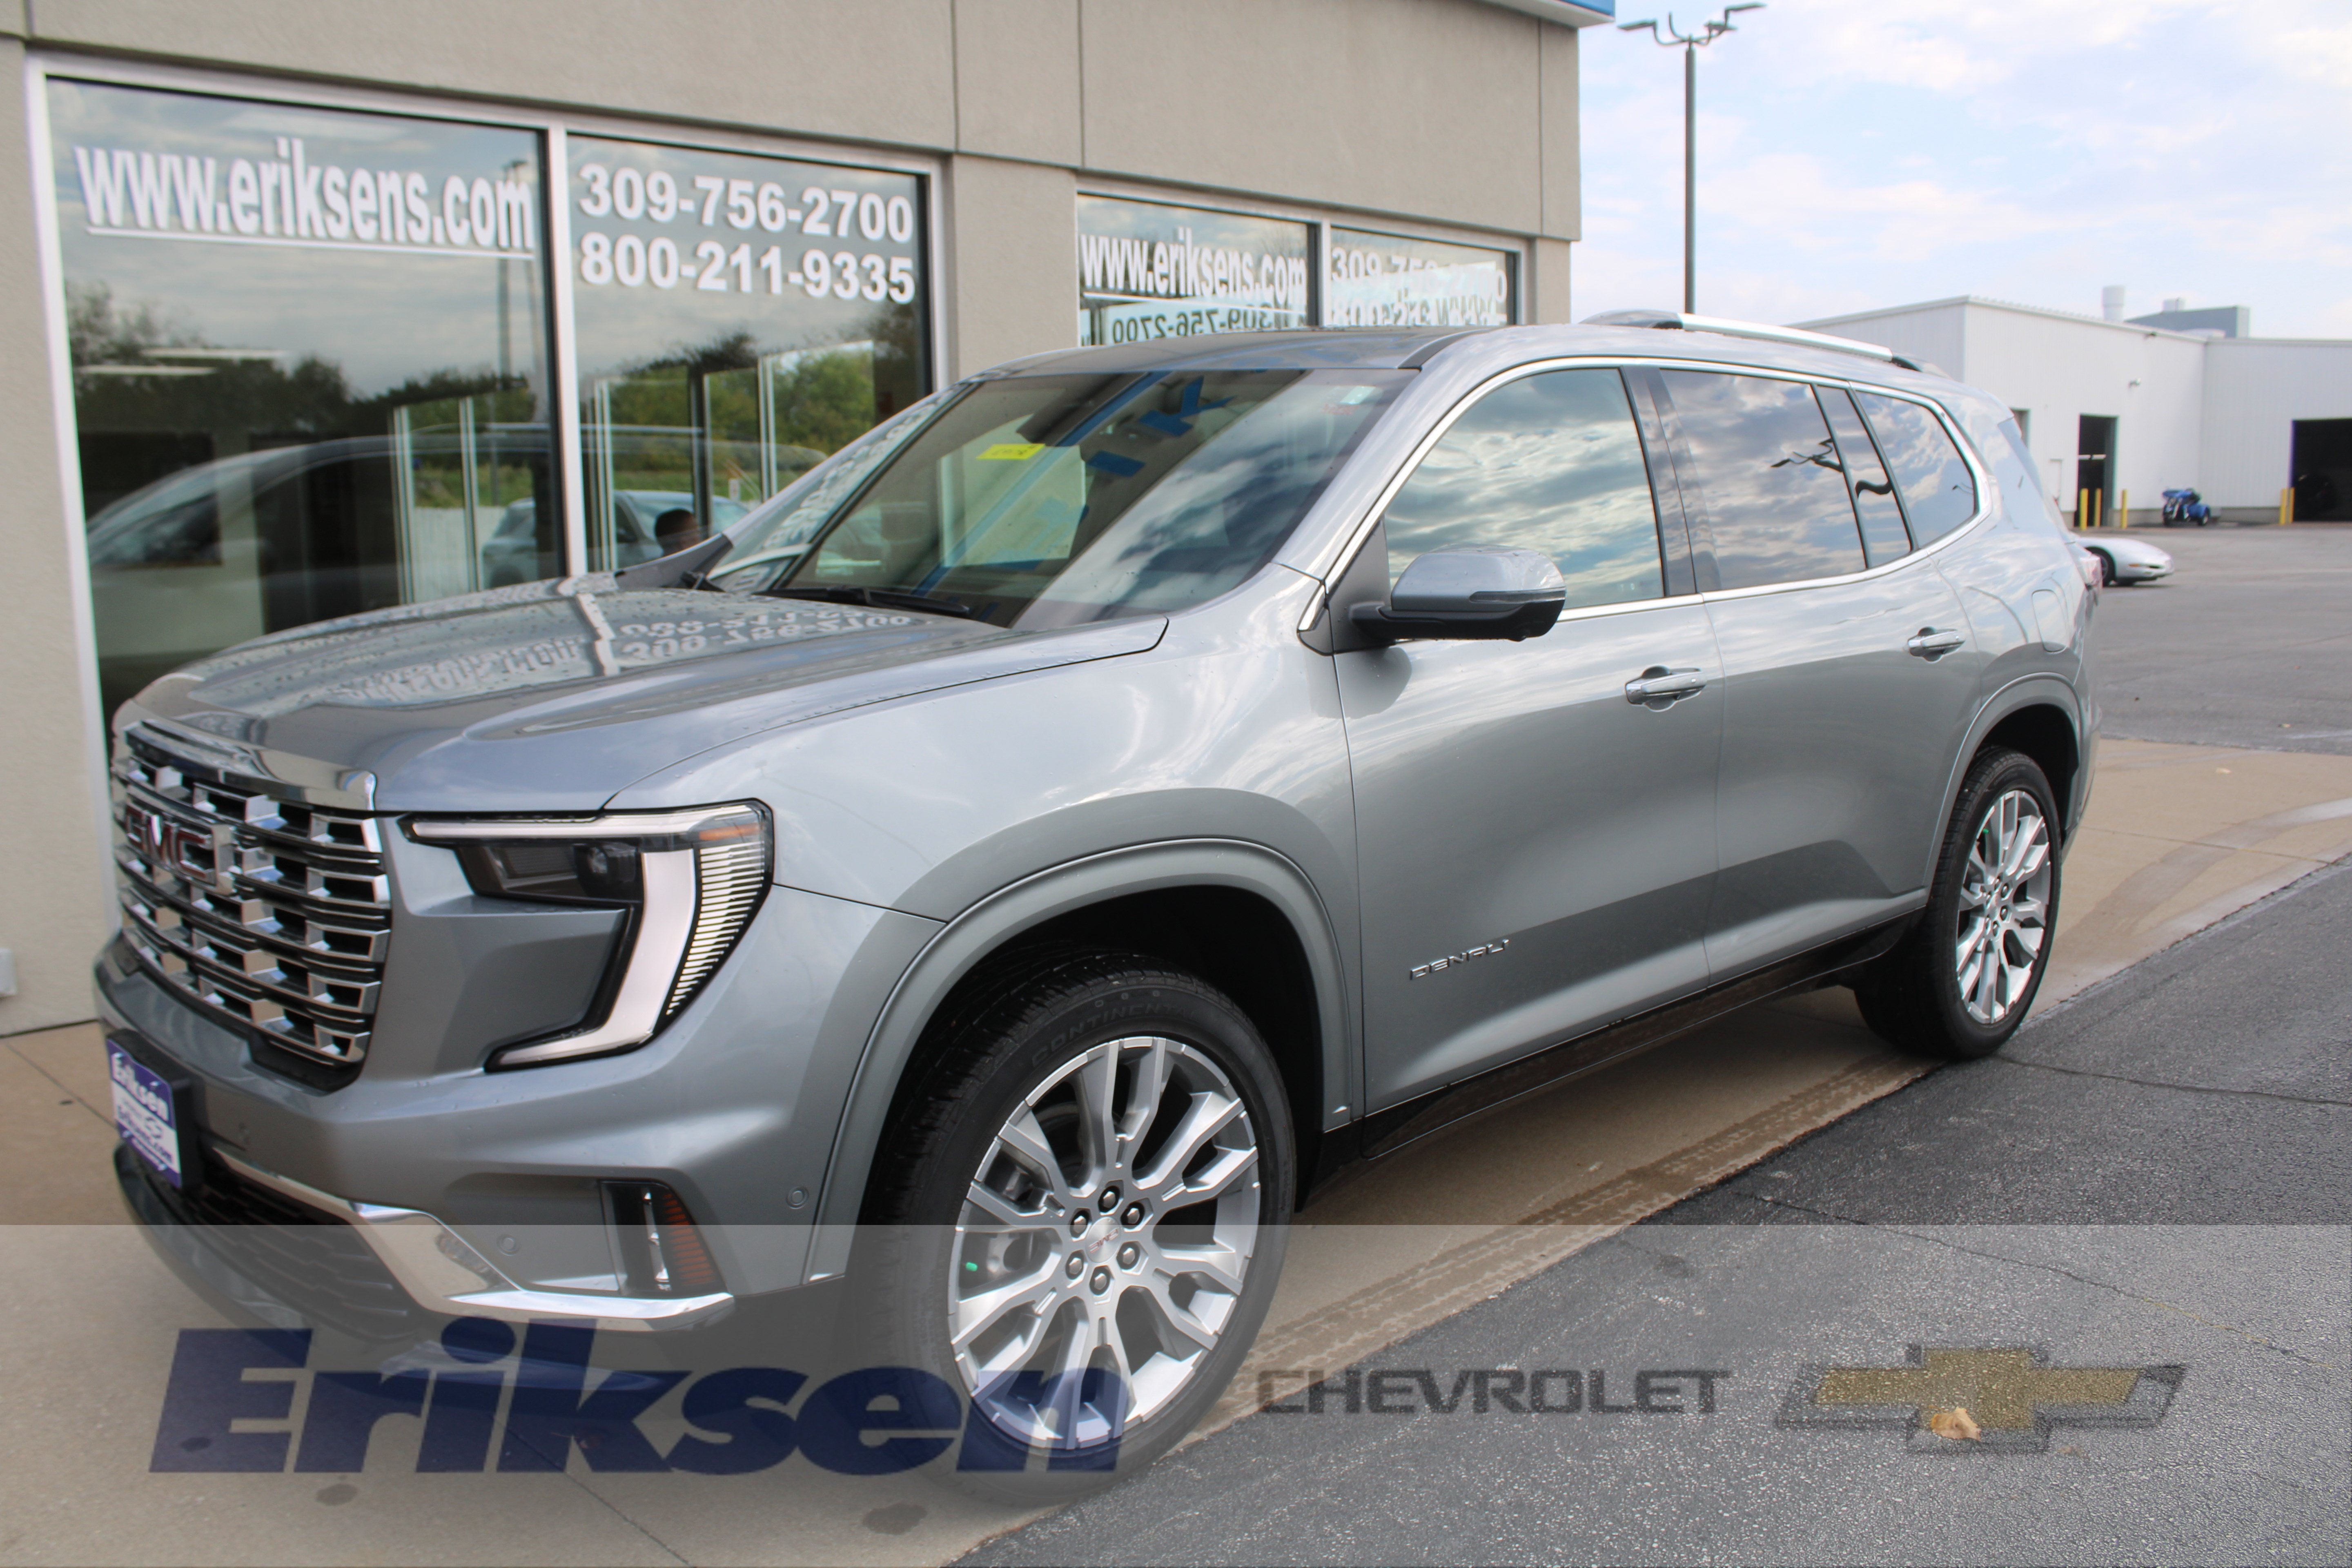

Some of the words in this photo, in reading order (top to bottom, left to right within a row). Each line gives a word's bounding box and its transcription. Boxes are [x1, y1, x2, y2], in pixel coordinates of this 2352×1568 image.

[74, 136, 535, 249] www.eriksens.com
[579, 163, 914, 244] 309-756-2700
[580, 231, 915, 305] 800-211-9335
[1080, 227, 1306, 307] www.eriksens.com
[1410, 939, 1510, 980] DENALI
